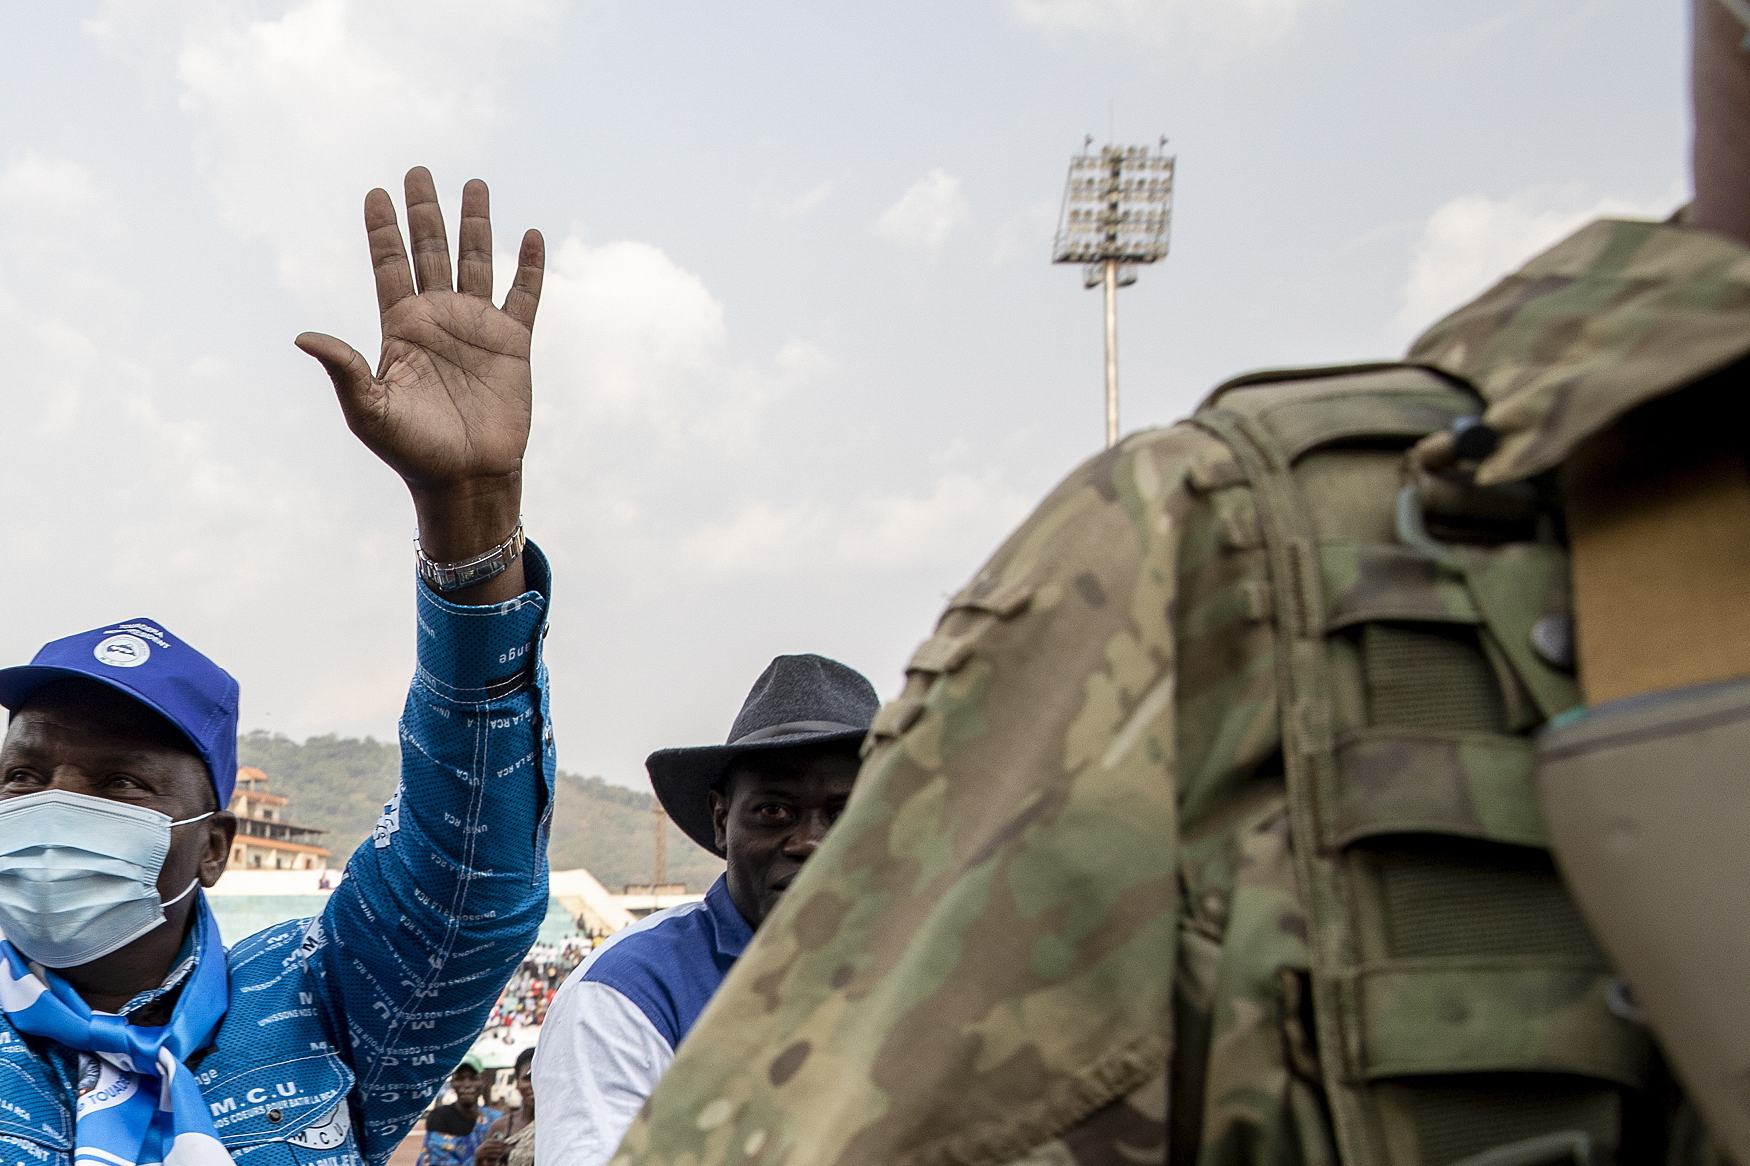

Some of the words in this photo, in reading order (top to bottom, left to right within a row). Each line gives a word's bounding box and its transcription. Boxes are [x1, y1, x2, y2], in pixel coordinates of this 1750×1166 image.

[490, 718, 511, 730] RCA
[512, 716, 525, 728] LA
[496, 764, 514, 779] RCA
[444, 812, 462, 827] RCA
[430, 852, 448, 870] RCA
[414, 887, 432, 908] RCA
[352, 958, 368, 974] RCA
[1, 1100, 14, 1112] LA
[210, 1082, 304, 1117] M.C.U.
[230, 1106, 266, 1126] COEURS
